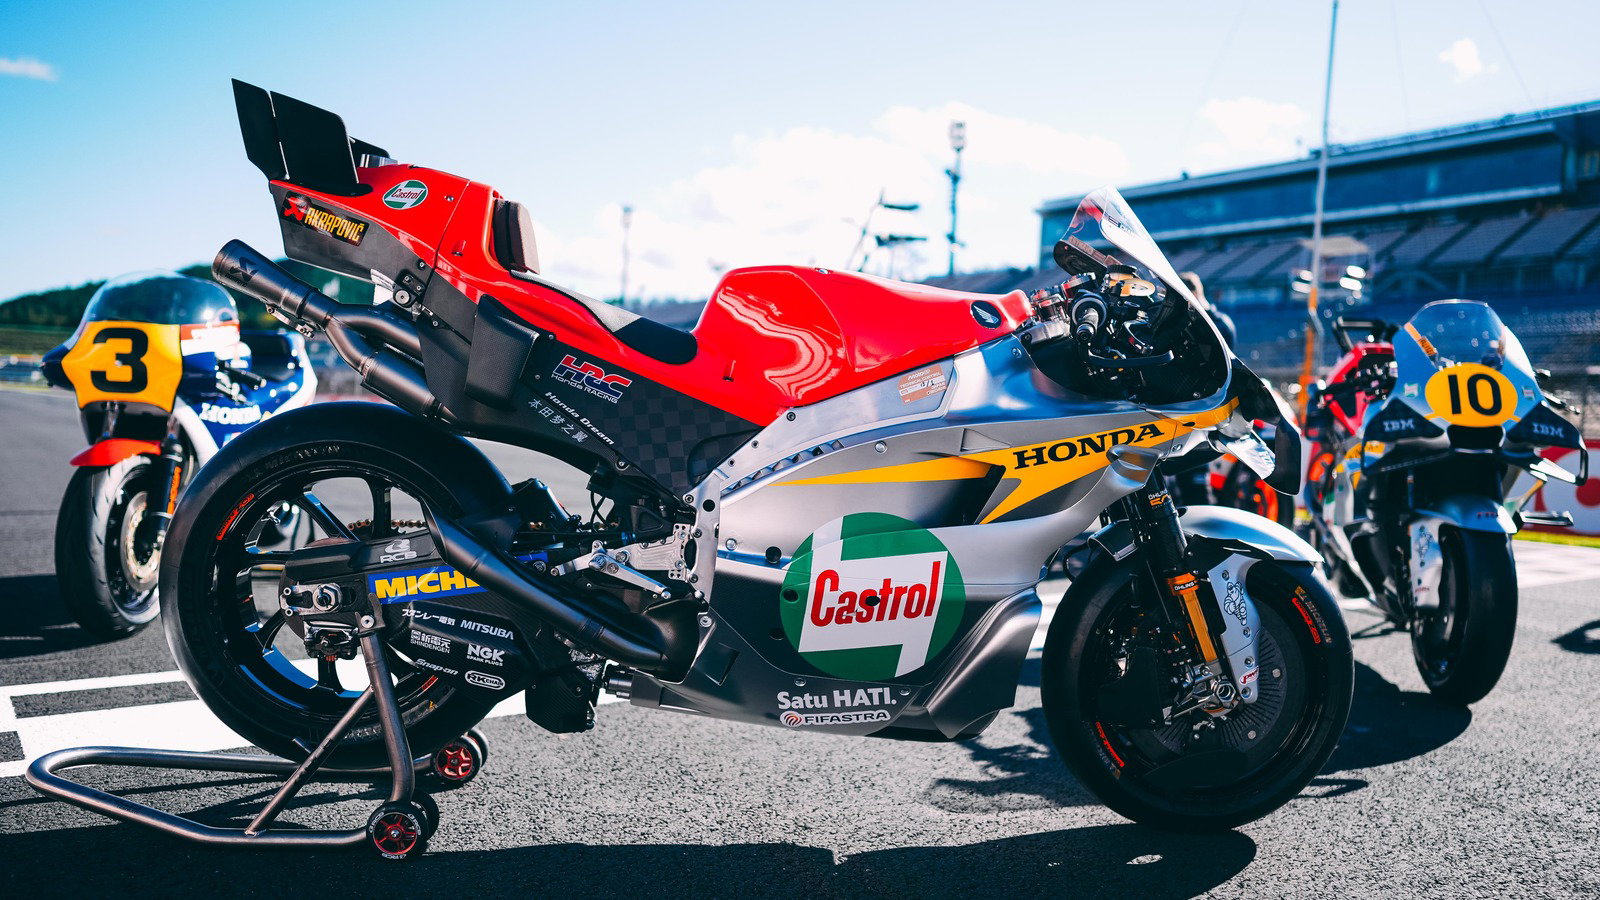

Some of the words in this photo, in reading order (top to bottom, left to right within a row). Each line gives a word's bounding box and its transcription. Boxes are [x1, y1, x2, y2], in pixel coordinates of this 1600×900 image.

[391, 188, 423, 200] Castrol
[91, 327, 149, 393] 3
[552, 354, 632, 400] HRC
[551, 374, 583, 390] Honda
[584, 387, 618, 404] RACING
[1447, 374, 1503, 416] 10
[545, 391, 580, 419] Honda
[580, 417, 615, 446] Dream
[1383, 418, 1416, 432] IBM
[1532, 422, 1565, 438] IBM
[1014, 421, 1165, 470] HONDA
[380, 551, 418, 563] RCB
[810, 560, 941, 628] Castrol
[460, 619, 514, 640] MITSUBA
[410, 639, 450, 654] SHINDENGEN
[467, 643, 505, 663] NGK
[416, 658, 459, 676] Snap-on
[777, 691, 828, 709] Satu
[833, 687, 897, 708] HATI.
[804, 711, 888, 724] FIFASTRA
